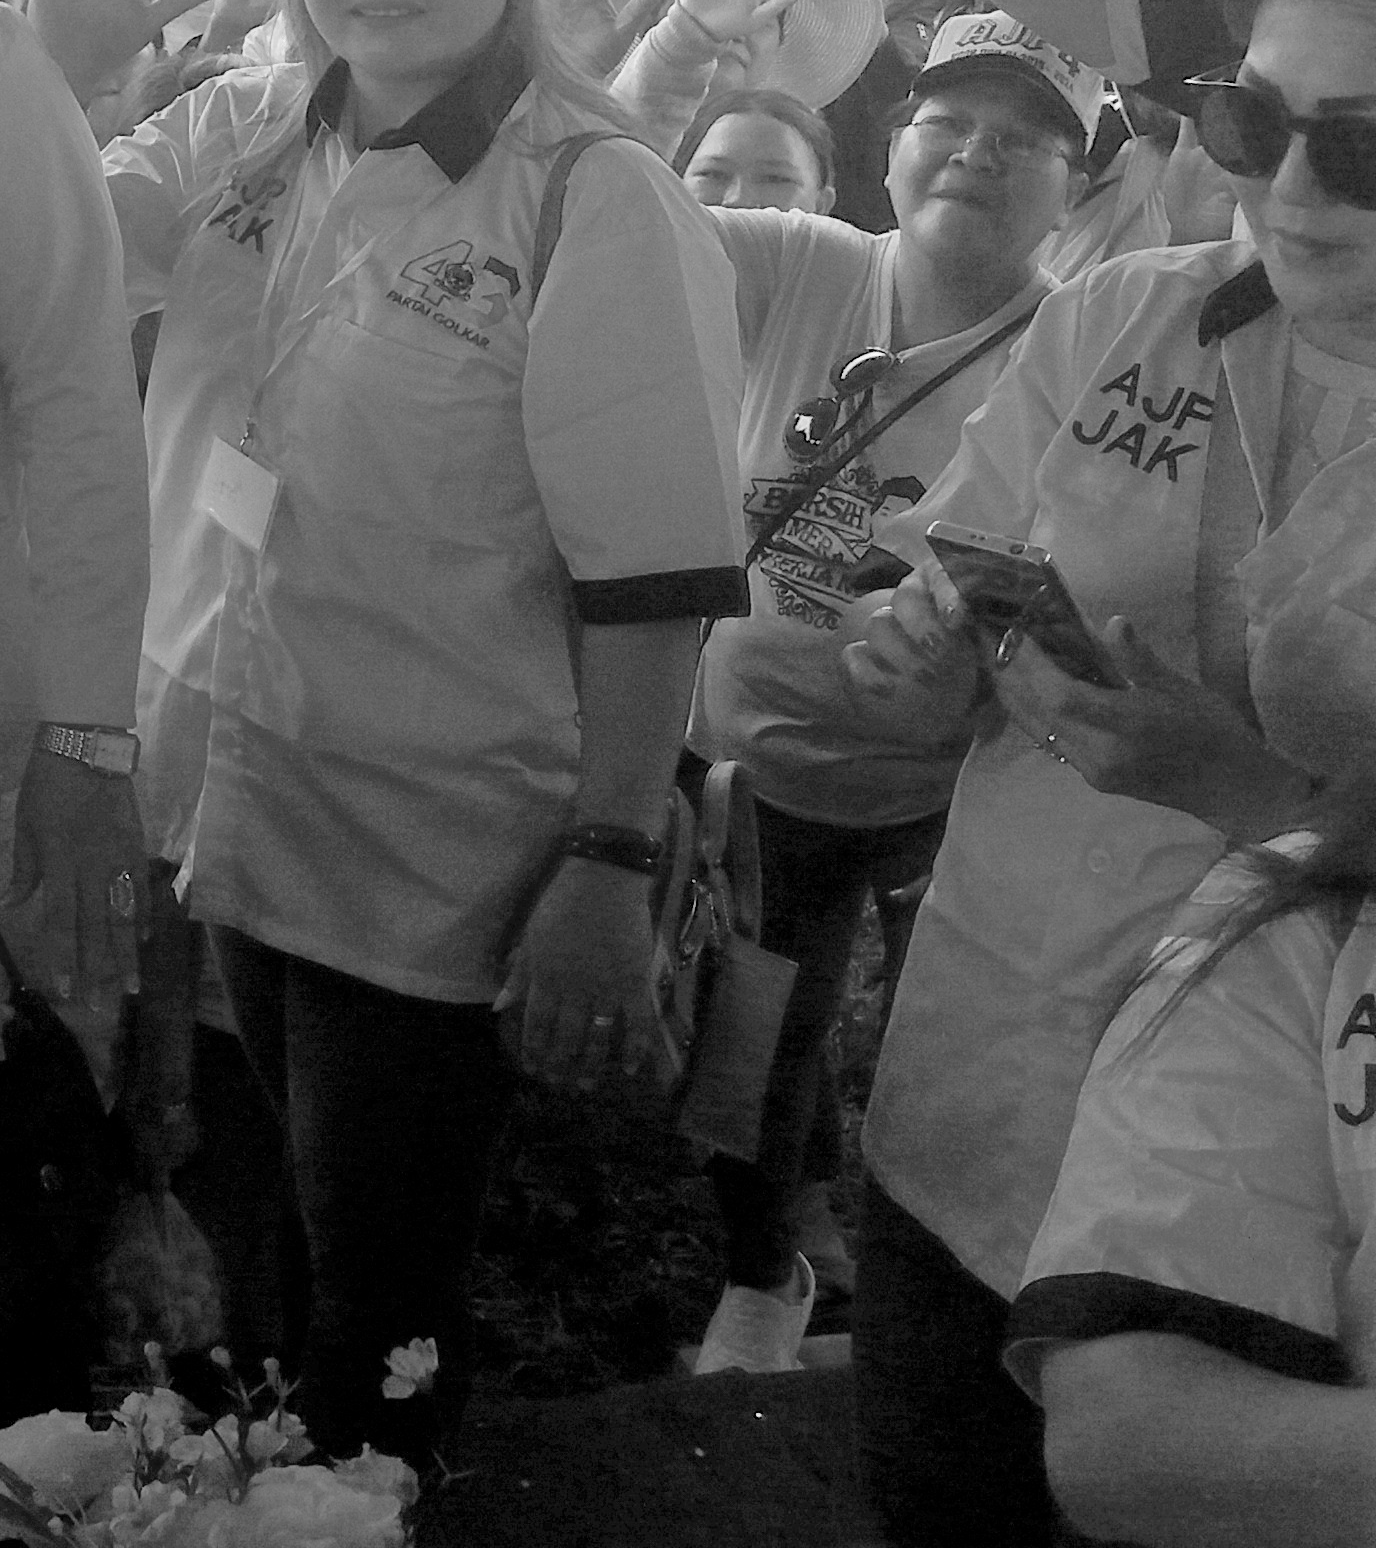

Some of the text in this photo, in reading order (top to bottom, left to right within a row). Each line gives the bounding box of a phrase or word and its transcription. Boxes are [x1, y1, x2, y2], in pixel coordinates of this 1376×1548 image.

[385, 289, 491, 350] PARTAI GOLKAR
[1072, 409, 1200, 483] JAK
